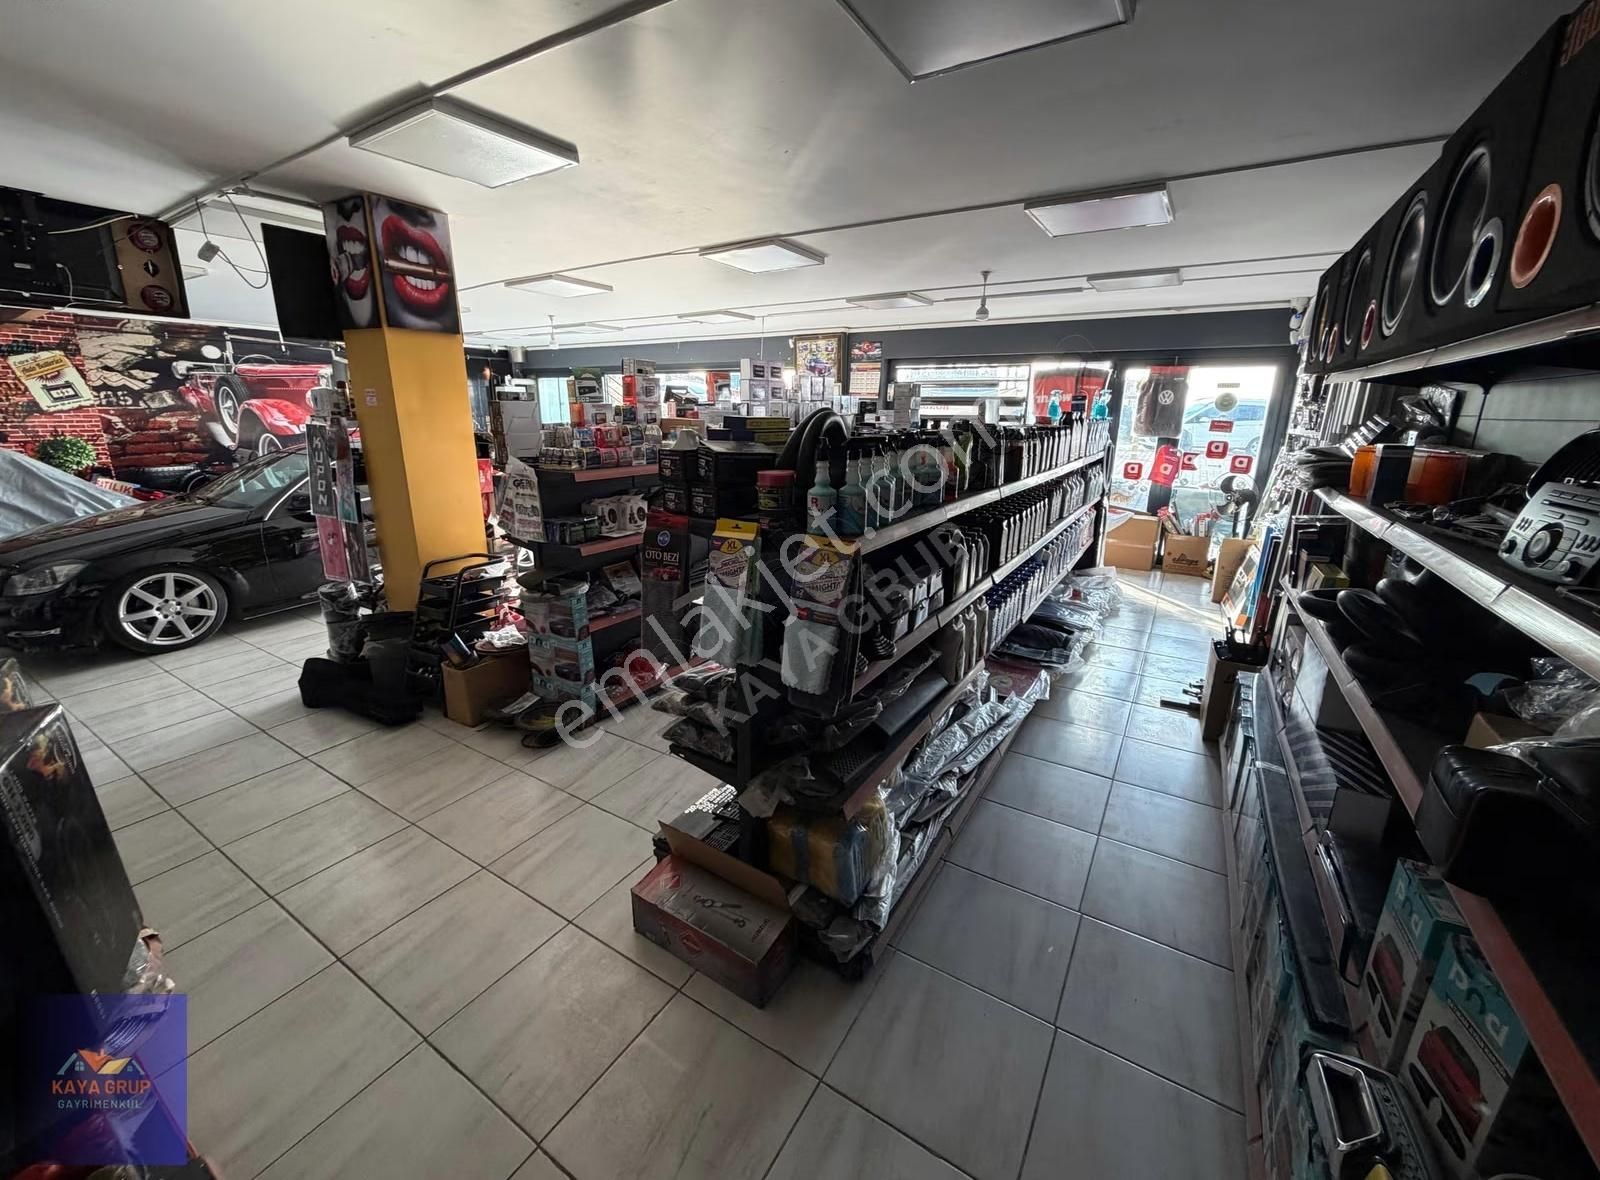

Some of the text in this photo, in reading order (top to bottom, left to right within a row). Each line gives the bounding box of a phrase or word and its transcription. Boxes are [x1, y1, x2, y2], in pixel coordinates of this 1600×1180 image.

[312, 436, 328, 507] KUPON
[727, 540, 738, 550] XL
[645, 549, 661, 560] OTO
[820, 552, 832, 563] XL
